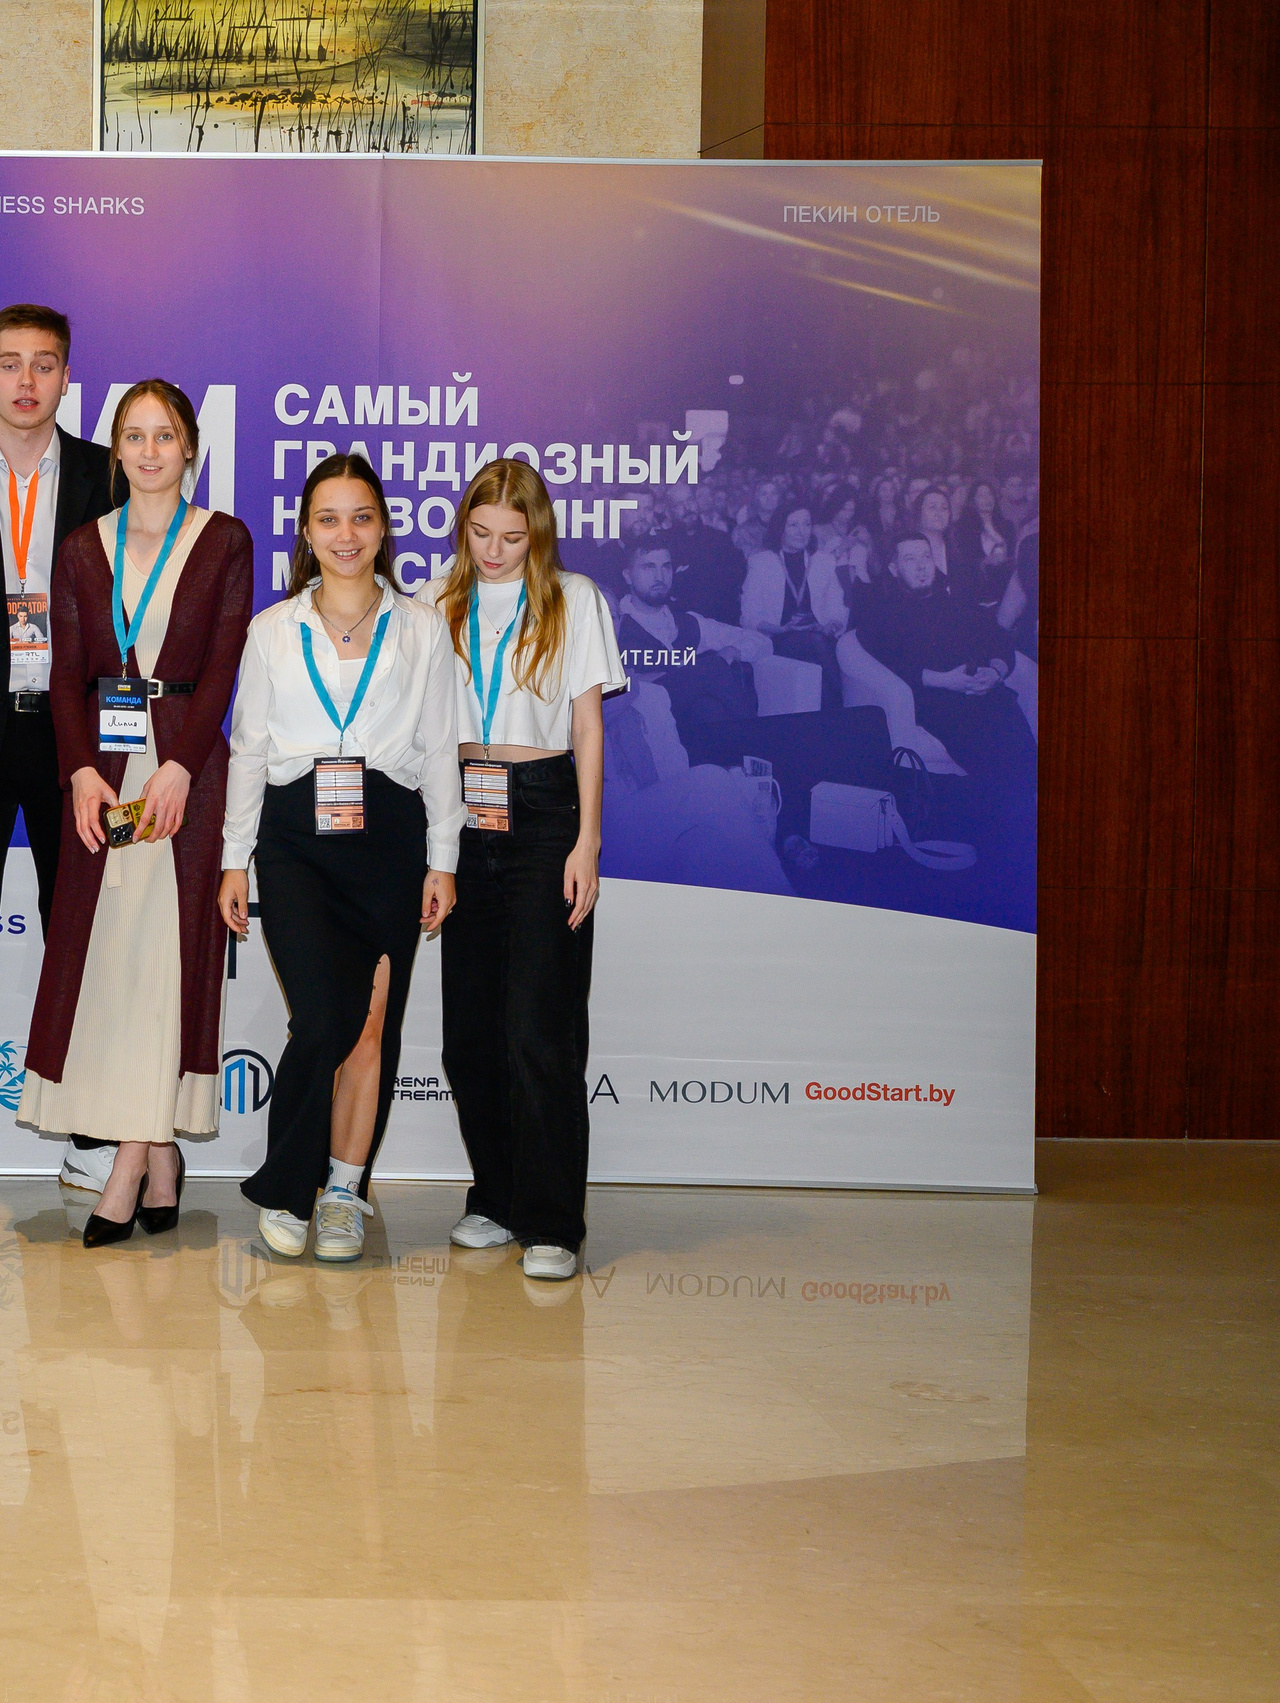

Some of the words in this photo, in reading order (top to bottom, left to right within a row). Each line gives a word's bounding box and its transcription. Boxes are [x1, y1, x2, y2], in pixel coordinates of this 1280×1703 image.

[53, 196, 146, 216] SHARKS
[783, 205, 858, 223] ПЕКИН
[865, 205, 940, 224] ОТЕЛЬ
[273, 371, 480, 427] САМЫЙ
[272, 430, 700, 491] ГРНДИЗНЫЙ
[105, 696, 142, 706] КОМАНДА
[393, 1076, 440, 1088] RENA
[391, 1089, 455, 1101] TREAM
[648, 1080, 790, 1105] MODUM
[804, 1081, 956, 1106] GoodStart.by
